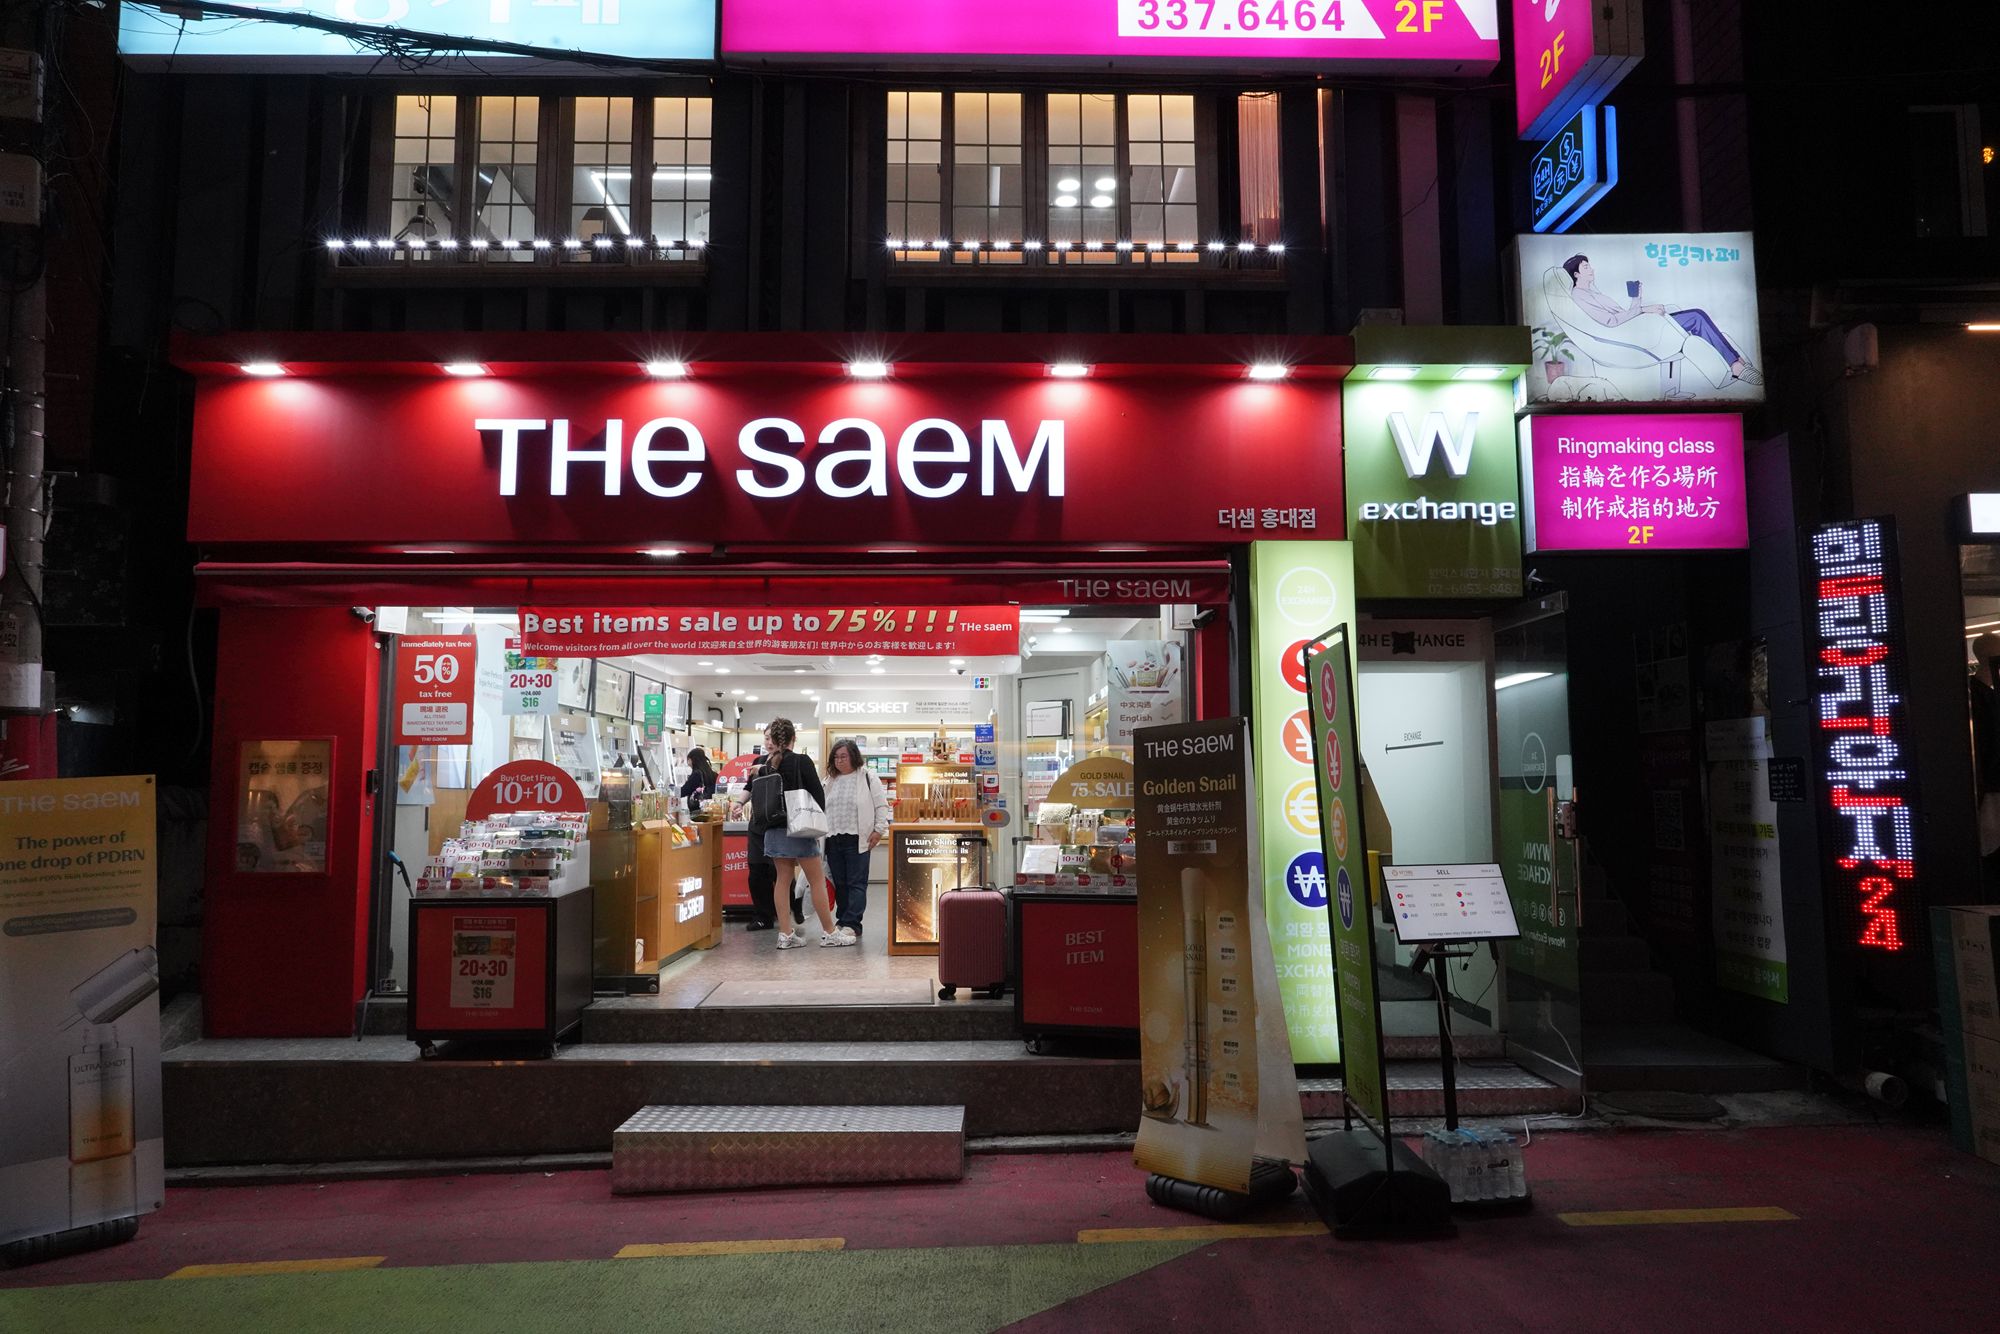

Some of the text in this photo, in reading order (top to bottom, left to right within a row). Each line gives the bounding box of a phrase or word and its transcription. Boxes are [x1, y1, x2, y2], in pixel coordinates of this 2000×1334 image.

[1395, 0, 1444, 33] 2F
[1539, 30, 1565, 90] 2F
[1644, 242, 1740, 268] 힐링카페
[1387, 411, 1479, 479] W
[1557, 437, 1715, 458] Ringmaking class
[1558, 464, 1718, 489] 指輪を作る場所
[1360, 496, 1516, 526] exchange
[1561, 495, 1720, 520] 制作戒指的地方
[1218, 508, 1316, 529] 더샘 홍대점
[1627, 526, 1655, 544] 2F
[524, 613, 584, 634] Best
[593, 611, 669, 634] items
[680, 611, 737, 632] sale
[748, 614, 783, 635] up
[793, 612, 820, 632] to
[401, 640, 445, 649] immediately
[457, 640, 472, 648] free
[524, 642, 563, 652] Welcome
[565, 642, 597, 652] visitors
[599, 642, 620, 652] from
[622, 641, 632, 650] all
[633, 640, 653, 649] over
[654, 640, 669, 649] the
[671, 640, 696, 649] world
[1358, 633, 1465, 647] 4H EHANGE
[414, 653, 459, 684] 50
[510, 673, 553, 689] 20+30
[434, 690, 452, 698] free
[522, 697, 539, 708] $16
[866, 701, 909, 713] SHEET
[1120, 714, 1153, 722] English
[500, 774, 516, 783] Buy
[520, 774, 535, 782] Get
[539, 774, 556, 782] Free
[1080, 772, 1102, 780] GOLD
[1095, 782, 1134, 797] SALE
[1143, 773, 1236, 796] Golden Snail
[493, 782, 563, 804] 10+10
[15, 830, 126, 851] The power of
[905, 837, 970, 847] Luxury Skincre
[31, 855, 72, 871] drop
[76, 852, 95, 865] of
[97, 849, 145, 864] PDRN
[724, 862, 748, 872] SHEE
[1065, 930, 1104, 946] BEST
[1066, 949, 1104, 965] ITEM
[1287, 943, 1331, 957] MONE
[459, 959, 508, 977] 20+30
[1275, 964, 1337, 978] EXCHAN
[473, 987, 492, 999] $16
